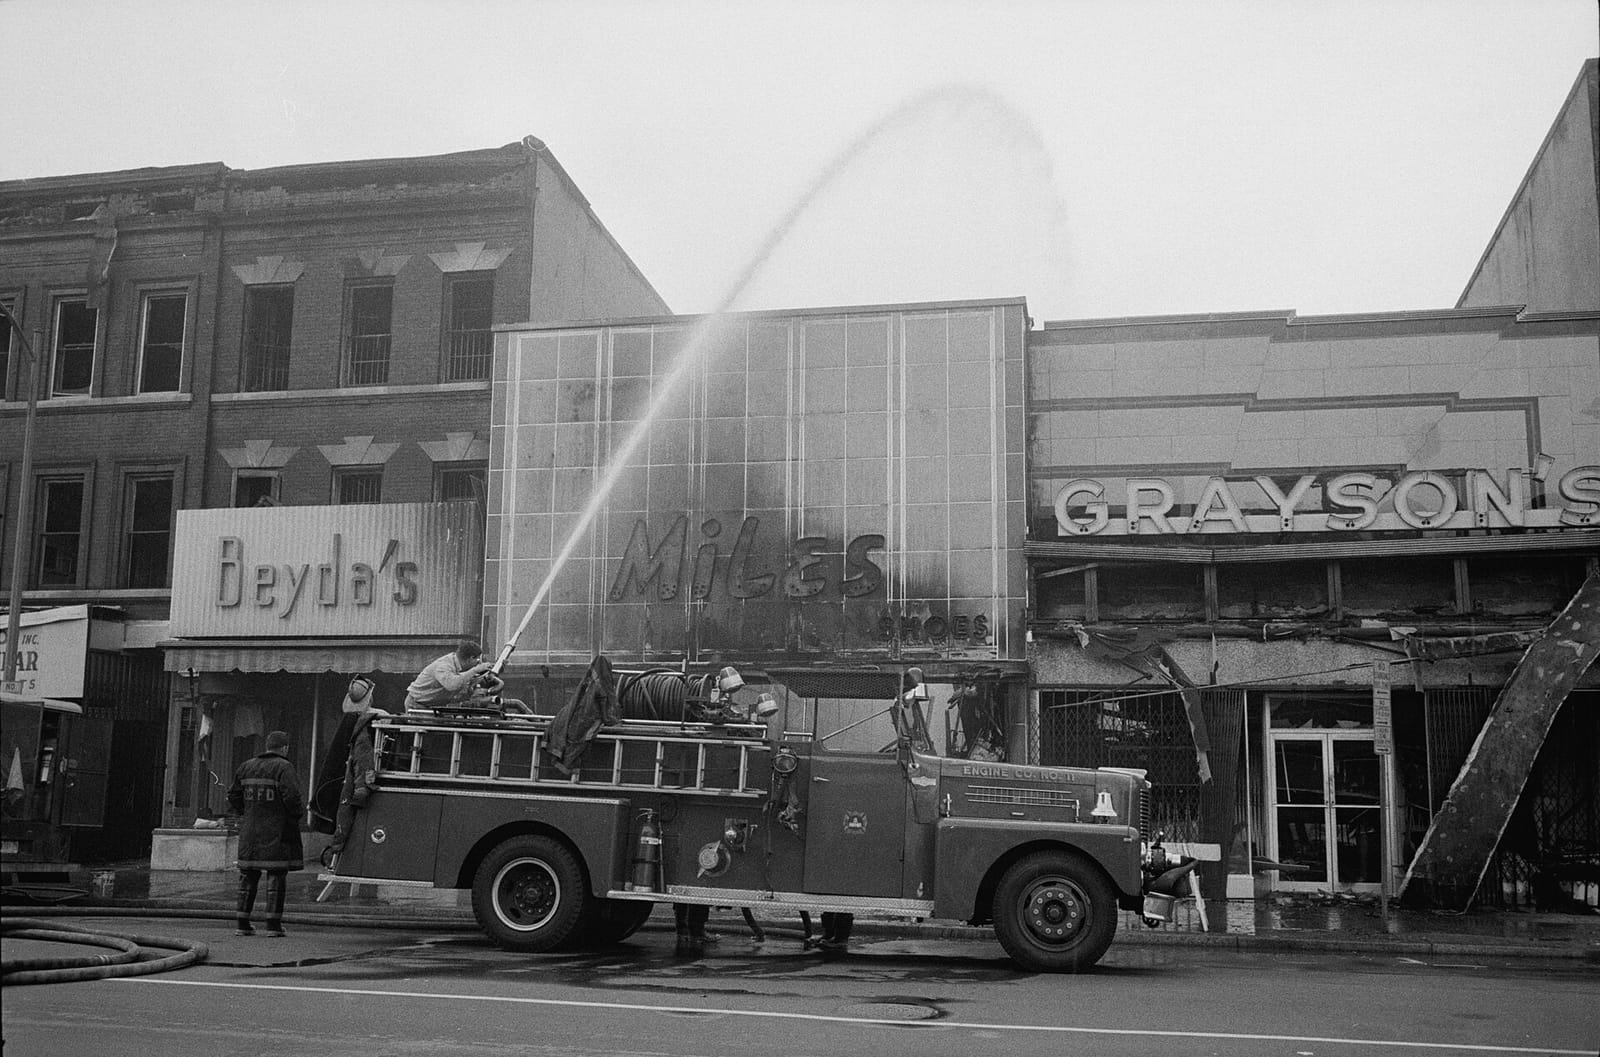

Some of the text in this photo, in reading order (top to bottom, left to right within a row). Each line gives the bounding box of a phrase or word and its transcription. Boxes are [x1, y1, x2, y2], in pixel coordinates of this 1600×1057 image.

[1054, 453, 1600, 536] GRAYSON'S
[215, 533, 418, 619] Beyda's
[22, 633, 40, 646] INC.
[880, 614, 988, 641] SHOES
[963, 766, 1009, 777] ENGINE
[1015, 769, 1037, 778] CO.
[1065, 773, 1075, 781] 11
